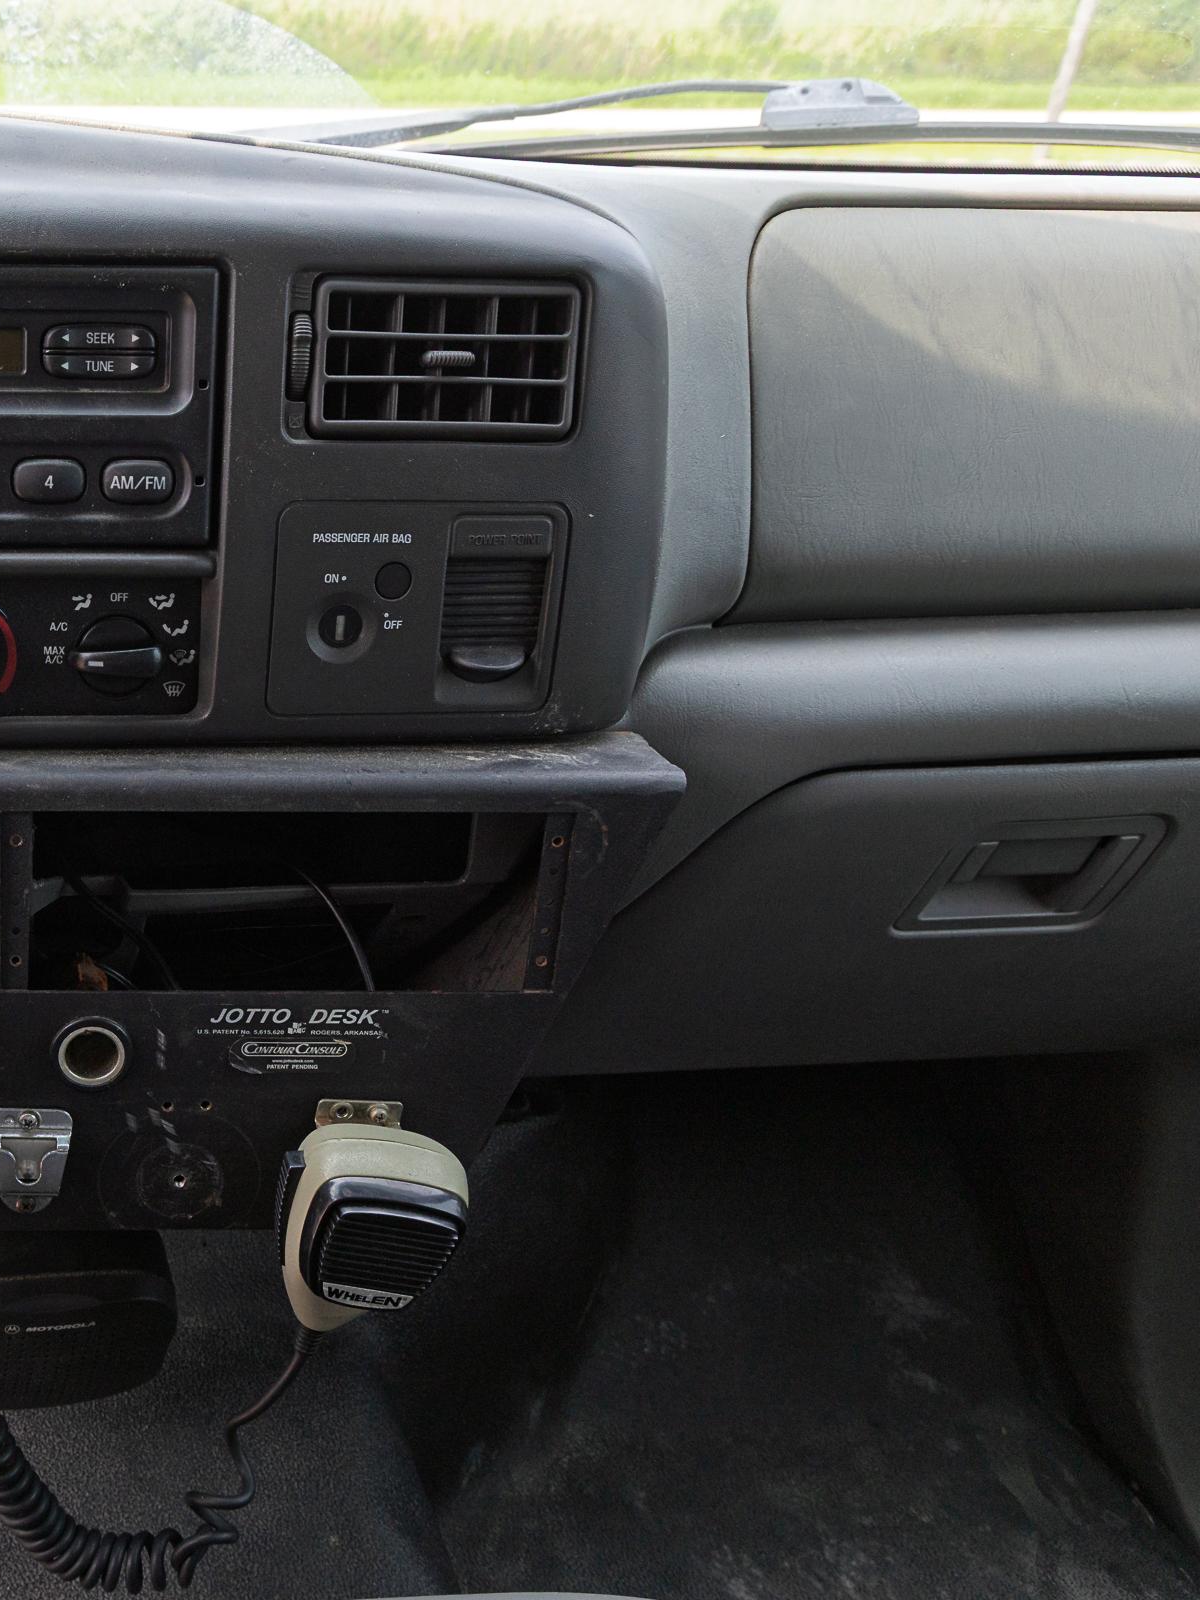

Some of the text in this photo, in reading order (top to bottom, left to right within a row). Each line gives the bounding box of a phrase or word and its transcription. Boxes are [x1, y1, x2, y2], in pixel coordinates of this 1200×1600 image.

[86, 332, 115, 344] SEEK
[85, 360, 115, 372] TUNE
[44, 475, 55, 489] 4
[110, 475, 166, 490] AM/FM
[312, 533, 412, 543] PASSENGER AIR BAG
[468, 534, 507, 546] POWER
[324, 573, 340, 583] ON
[110, 592, 129, 602] OFF
[49, 621, 68, 632] A/C
[383, 619, 403, 630] OFF
[43, 646, 66, 655] MAX
[44, 655, 64, 664] A/C
[210, 1008, 291, 1024] JOTTO
[308, 1008, 379, 1024] DESK
[327, 1286, 402, 1307] WHELEN
[25, 1321, 97, 1333] MOTOROLA
